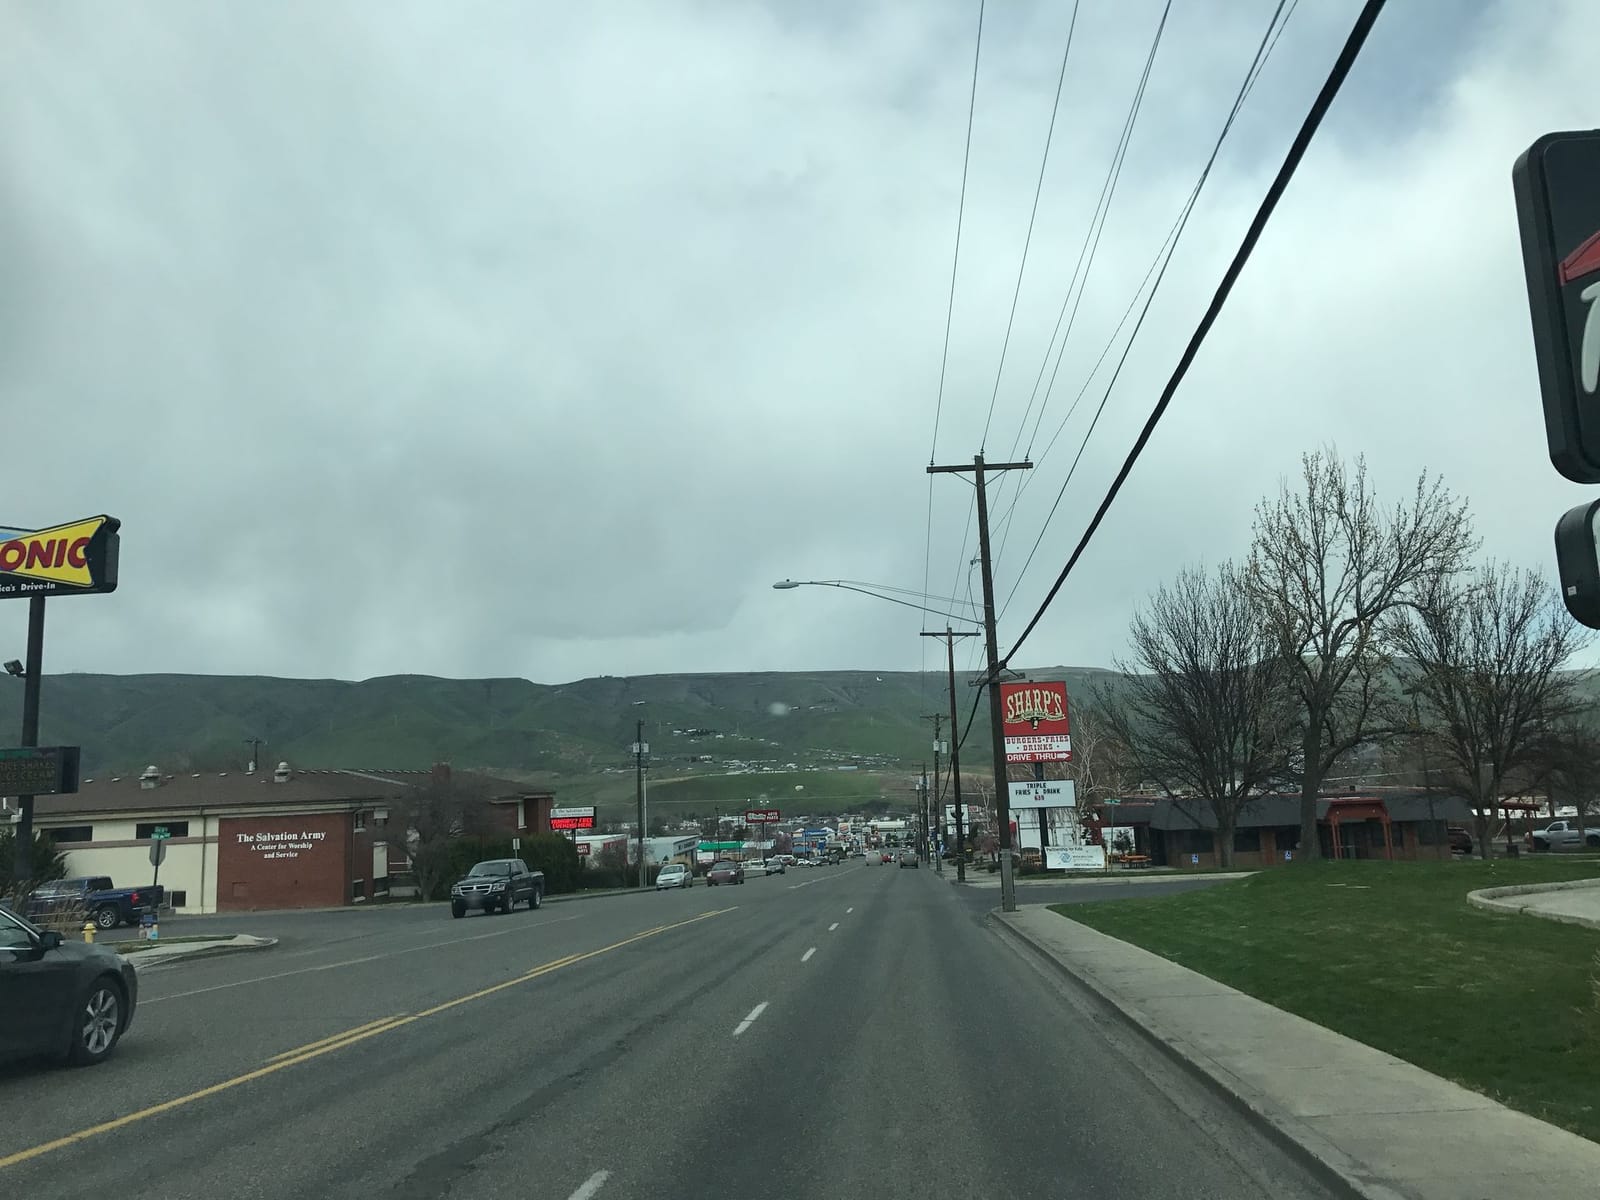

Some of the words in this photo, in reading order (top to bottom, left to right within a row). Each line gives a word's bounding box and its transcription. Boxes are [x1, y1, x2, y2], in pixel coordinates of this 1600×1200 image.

[21, 582, 56, 591] Drive-In
[1007, 689, 1063, 719] SHARP'S
[1007, 753, 1032, 761] DRIVE
[1035, 752, 1057, 760] THRU
[237, 833, 254, 843] The
[256, 832, 298, 842] Salvation
[300, 831, 326, 840] Army
[288, 842, 313, 850] Worship
